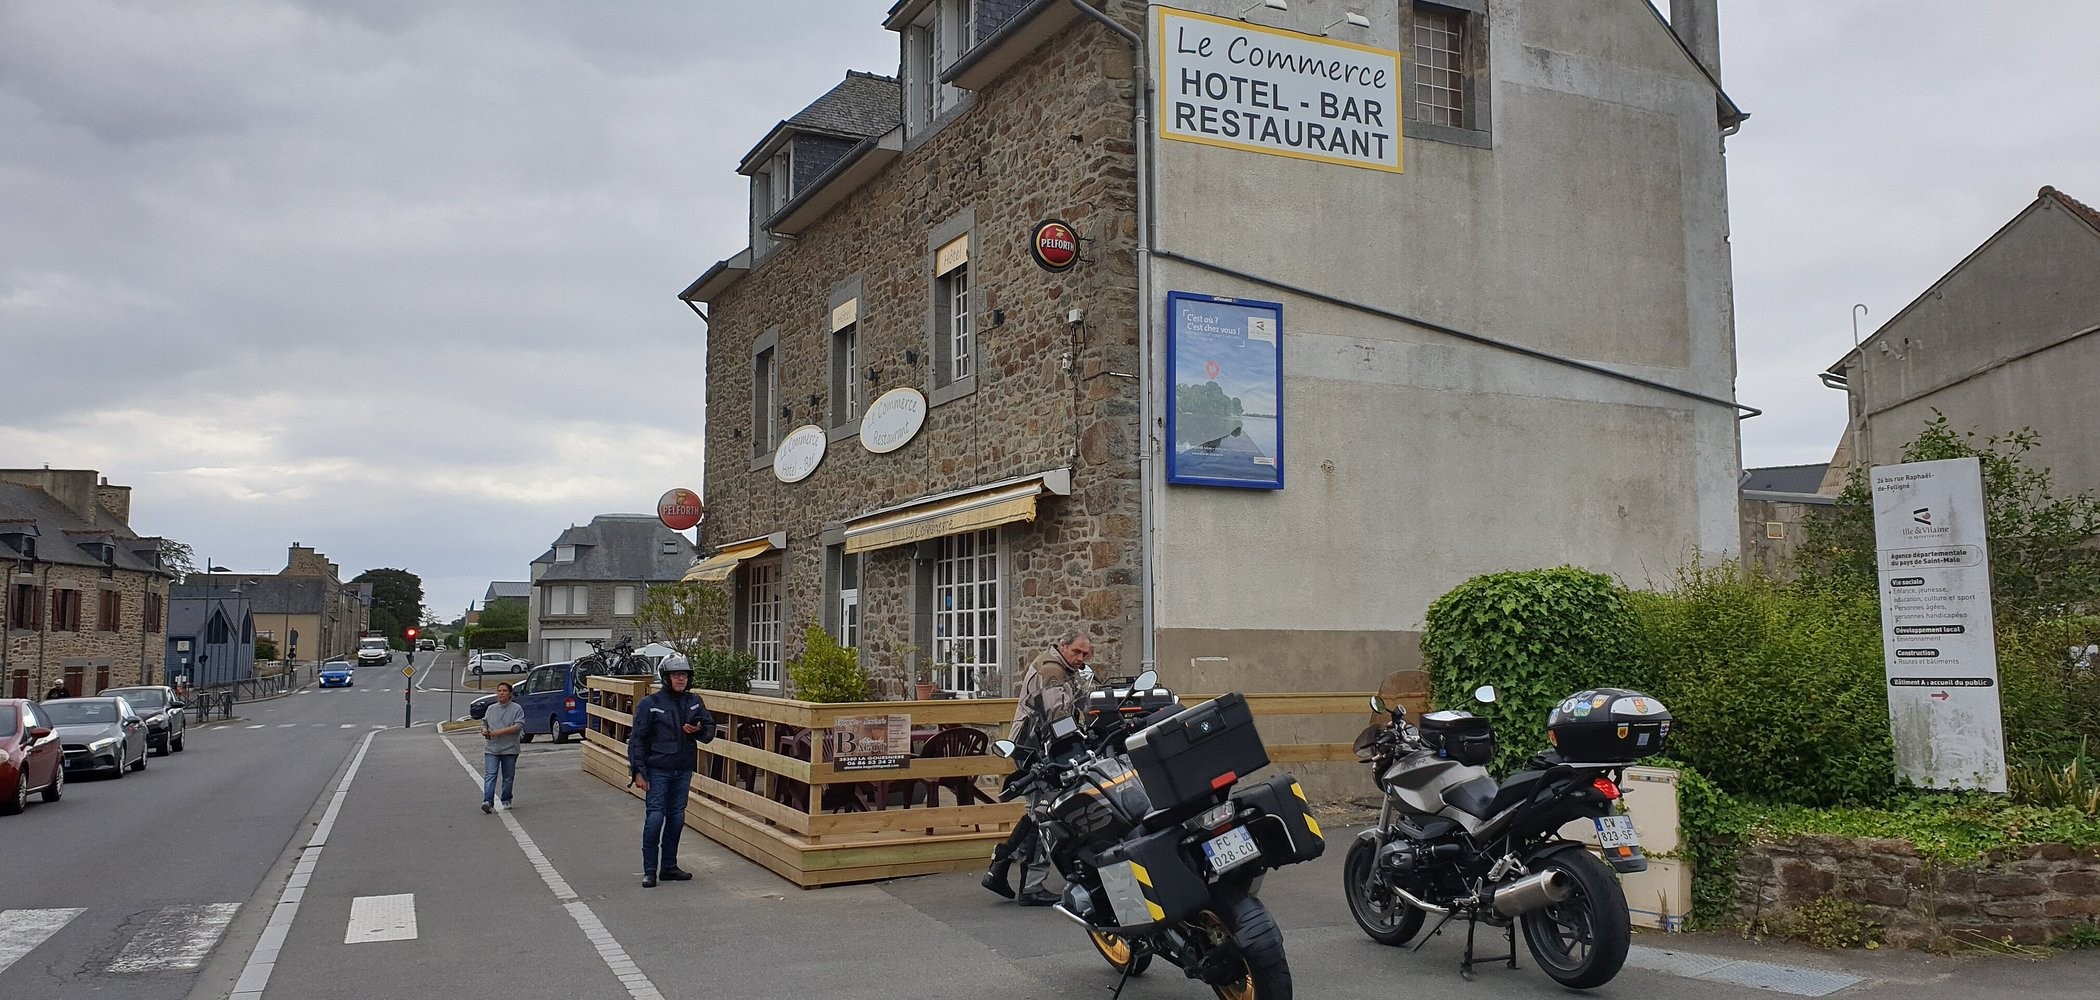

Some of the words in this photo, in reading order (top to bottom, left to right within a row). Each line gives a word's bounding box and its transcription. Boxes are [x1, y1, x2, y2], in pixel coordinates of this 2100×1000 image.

[1178, 26, 1213, 58] Le
[1228, 36, 1387, 89] Commerce
[1181, 67, 1289, 112] HOTEL
[1320, 91, 1383, 127] BAR
[1175, 101, 1389, 159] RESTAURANT
[1187, 322, 1203, 331] C'est
[1203, 324, 1219, 333] chez
[1220, 327, 1237, 335] vous
[878, 398, 917, 419] Commerce
[873, 420, 909, 446] Restaurant
[663, 505, 699, 515] PELFORTH
[1922, 526, 1949, 534] Vilaine
[1913, 550, 1967, 558] départementale
[1957, 594, 1976, 602] sport
[1926, 611, 1968, 619] handicapées
[1896, 626, 1943, 634] Développement
[1215, 836, 1231, 850] FC
